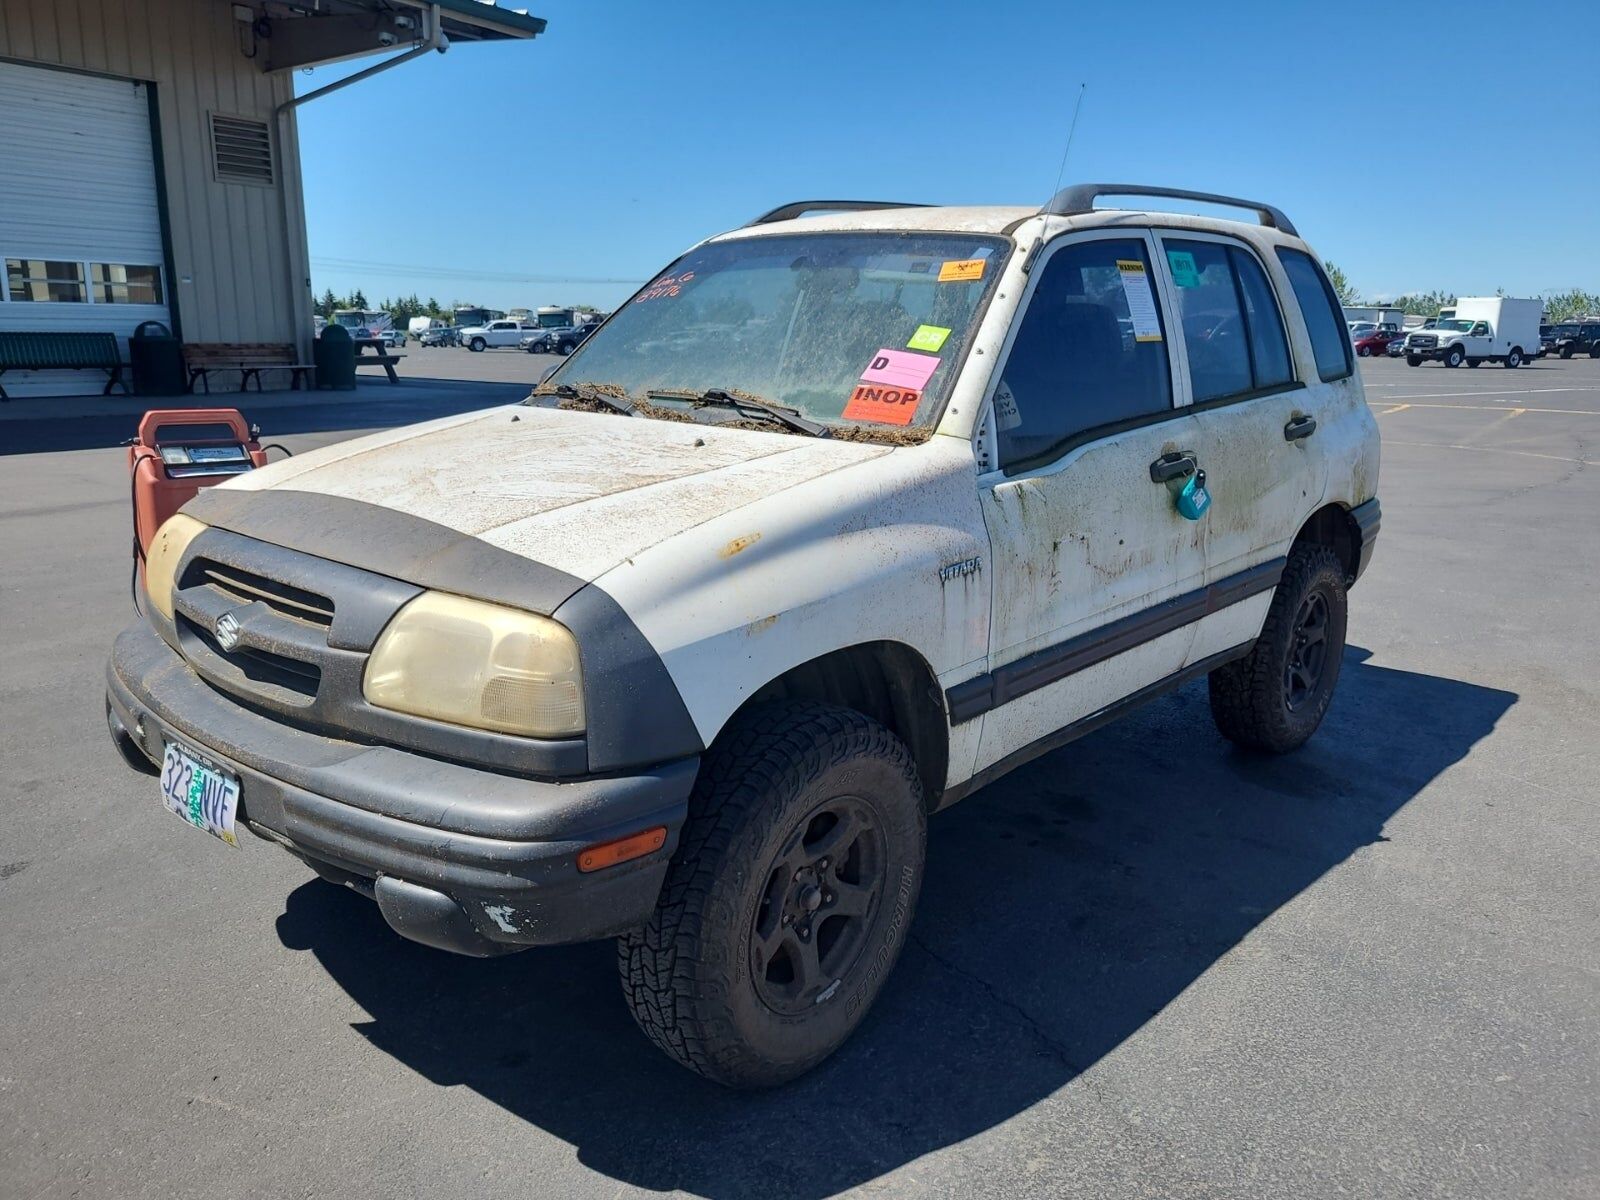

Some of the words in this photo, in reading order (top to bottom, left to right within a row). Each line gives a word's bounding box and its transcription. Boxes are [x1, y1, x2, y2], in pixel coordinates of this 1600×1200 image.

[1119, 264, 1144, 272] WARNING
[870, 356, 890, 370] D
[854, 387, 918, 405] INOP
[938, 556, 984, 582] VITARA
[162, 752, 193, 807] 323
[199, 774, 234, 830] NVF
[846, 864, 915, 1018] HERCULES
